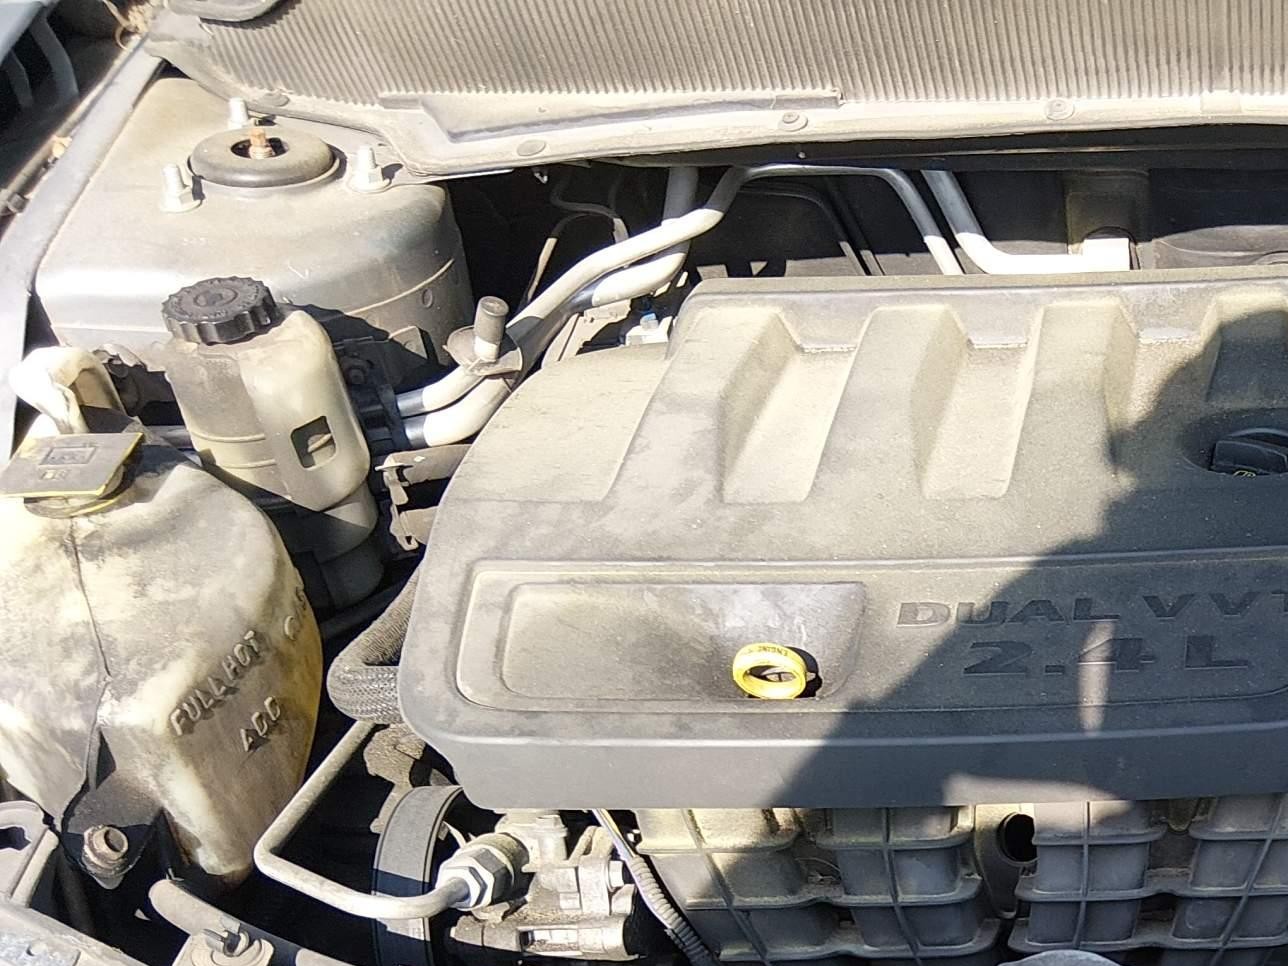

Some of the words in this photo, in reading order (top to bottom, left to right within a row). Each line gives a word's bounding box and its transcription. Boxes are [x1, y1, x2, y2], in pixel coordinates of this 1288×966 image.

[896, 597, 1121, 627] DUAL
[169, 676, 228, 737] FULL
[221, 629, 261, 681] HOT
[239, 695, 282, 752] ADD
